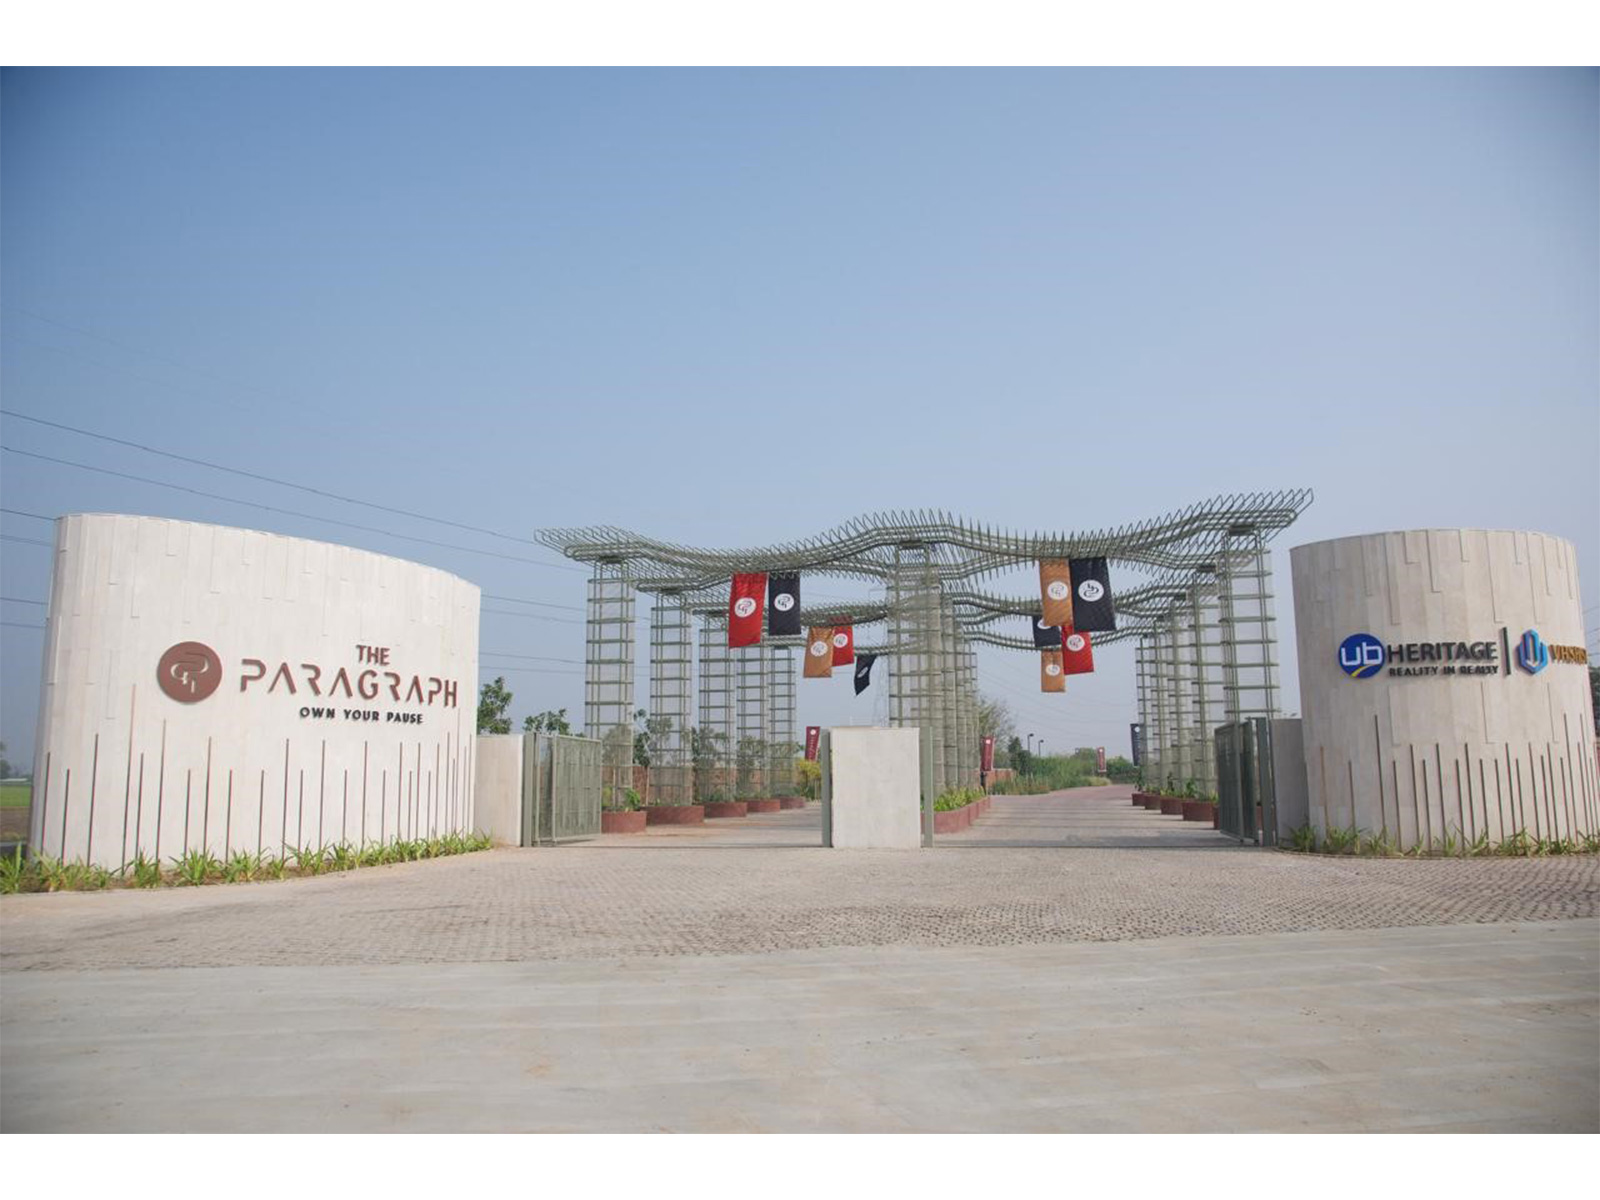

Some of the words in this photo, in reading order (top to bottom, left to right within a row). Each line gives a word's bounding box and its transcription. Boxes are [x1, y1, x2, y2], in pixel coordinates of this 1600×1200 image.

[356, 644, 390, 665] THE
[1387, 641, 1498, 663] HERITAGE
[1389, 667, 1438, 677] REALITY
[1443, 666, 1456, 675] IN
[240, 658, 457, 708] PARAGRAPH
[299, 707, 336, 719] OWN
[343, 709, 380, 721] YOUR
[386, 711, 423, 725] PAUSE
